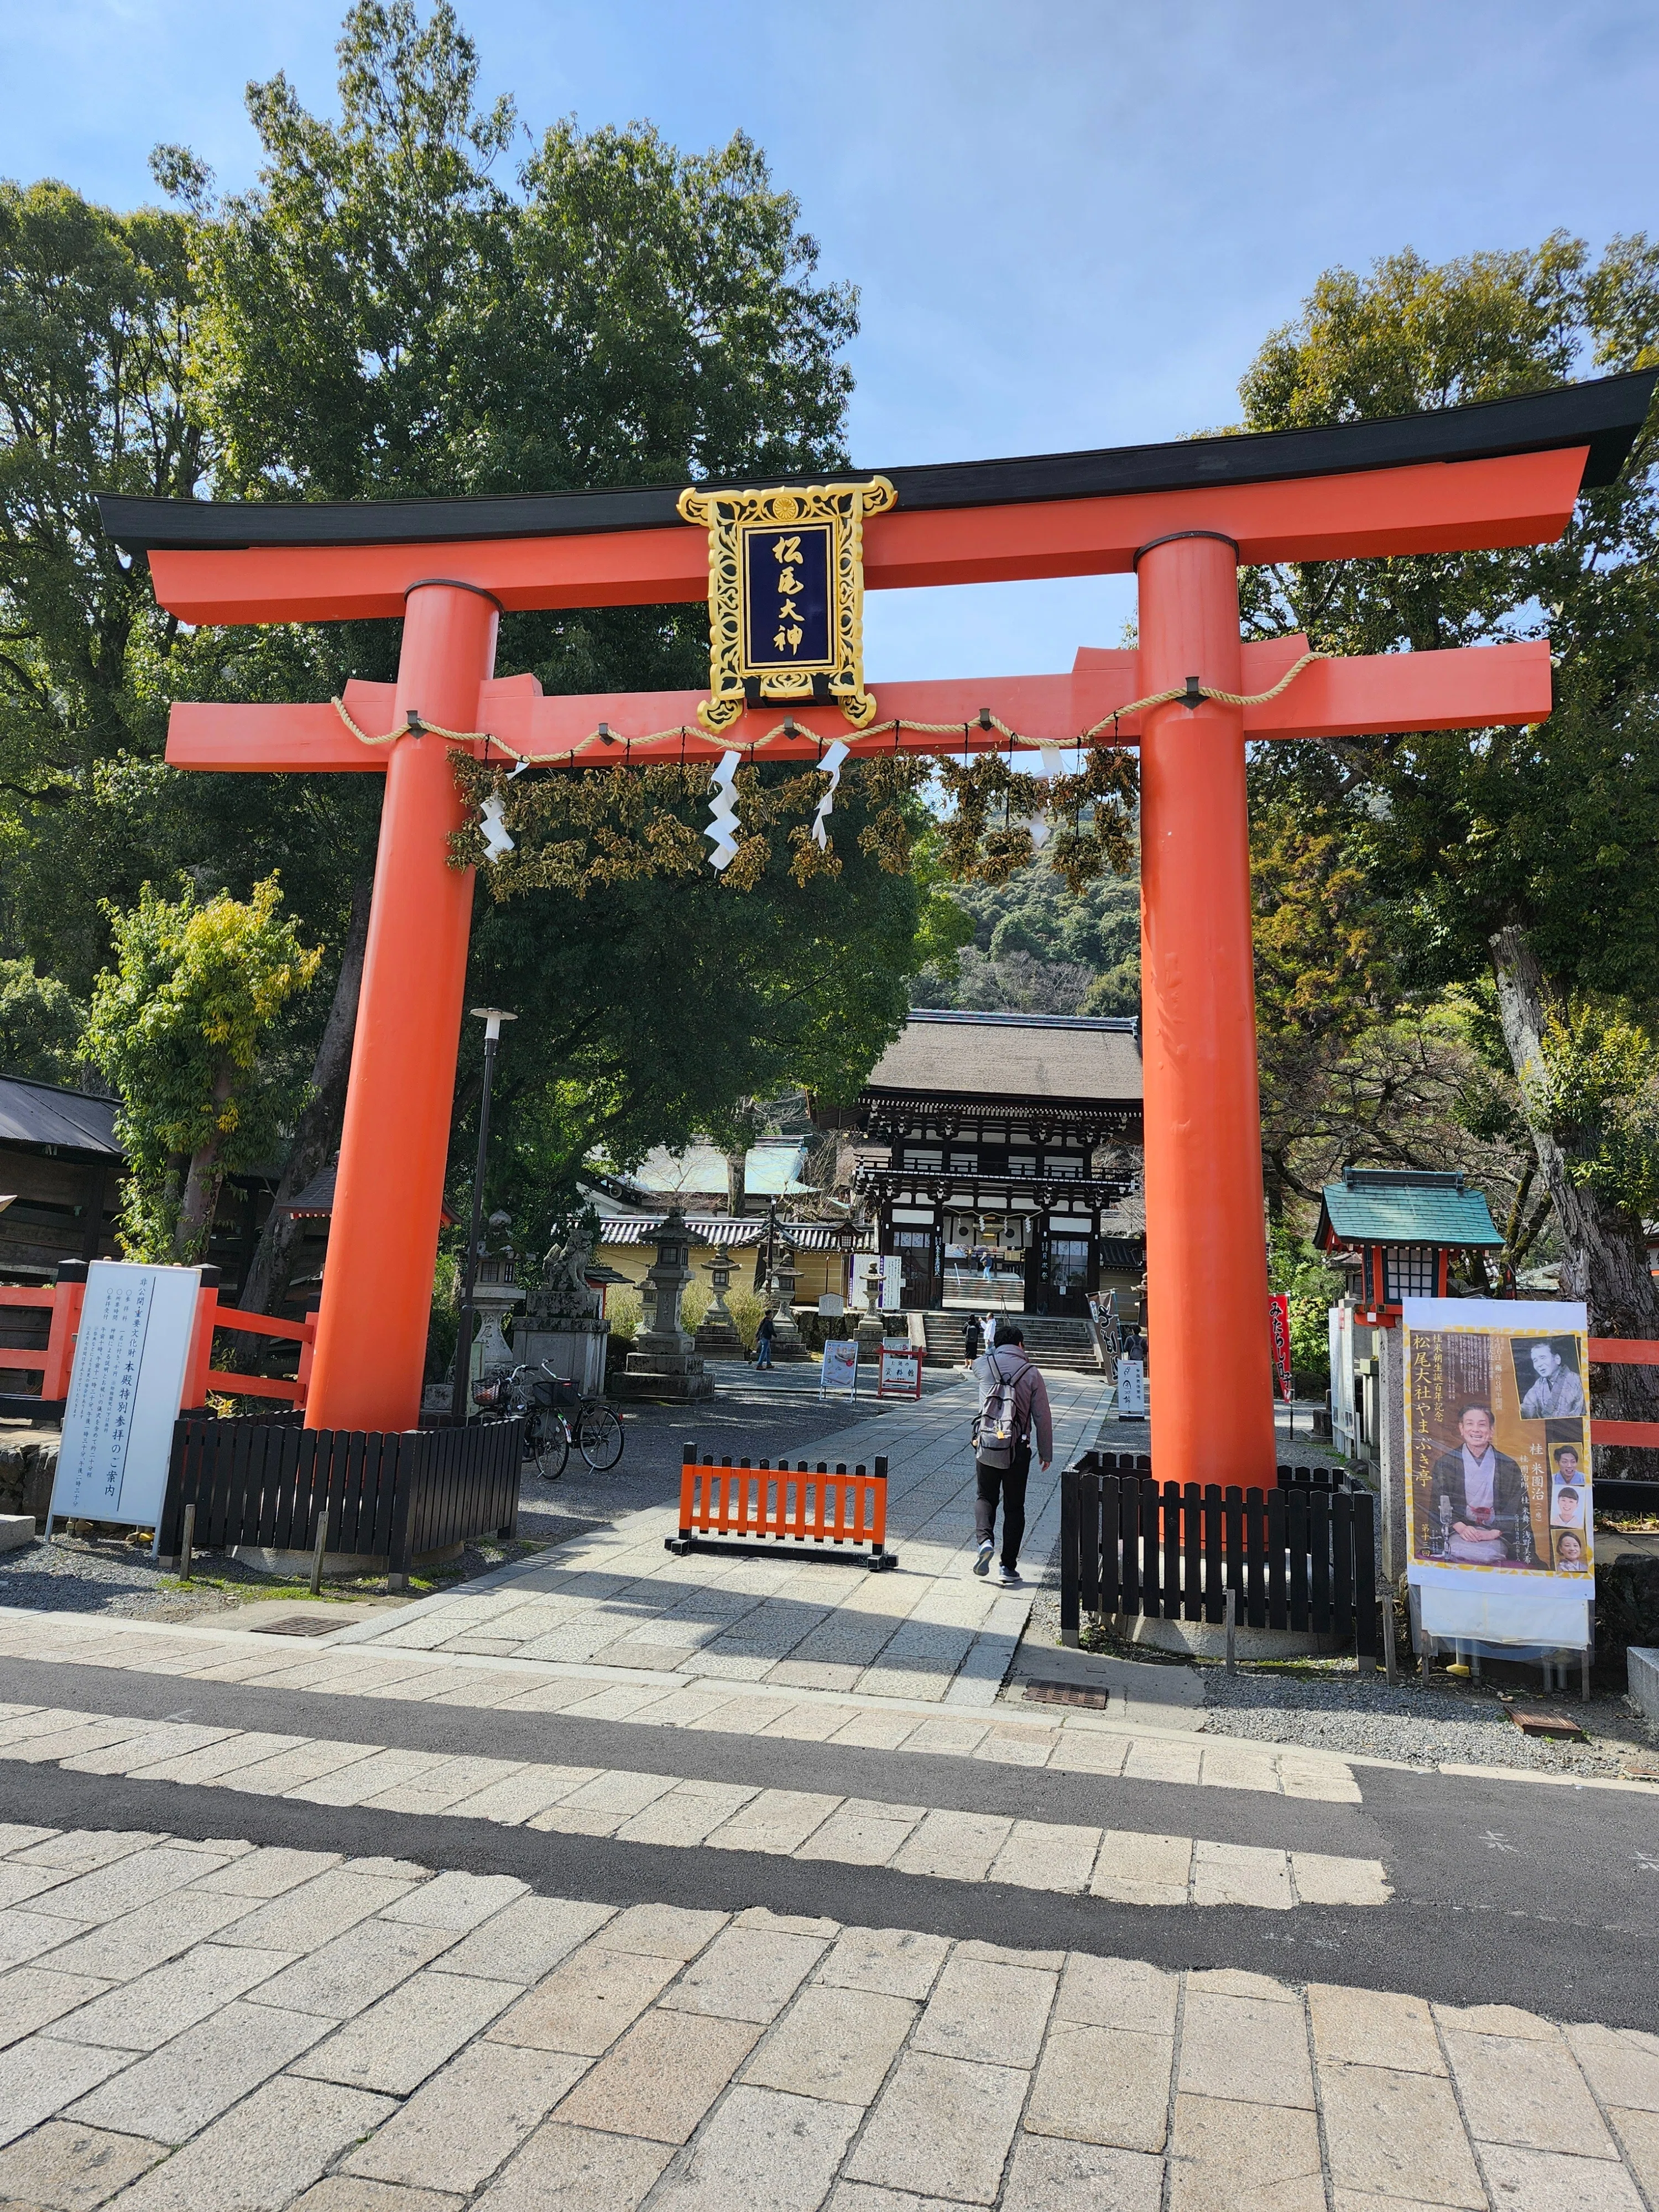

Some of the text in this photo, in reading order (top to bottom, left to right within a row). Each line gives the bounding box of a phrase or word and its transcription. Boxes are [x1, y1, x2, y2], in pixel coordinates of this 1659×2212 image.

[773, 535, 805, 656] 松尾大神
[105, 1277, 148, 1497] 非公開・重要文化財 本殿特別参拝のご案内
[885, 1367, 915, 1378] 資料館
[1413, 1334, 1433, 1488] 松尾大社やまぶき亭
[1432, 1333, 1444, 1422] 桂米朝生誕百年記念
[1421, 1524, 1431, 1557] 第十三回
